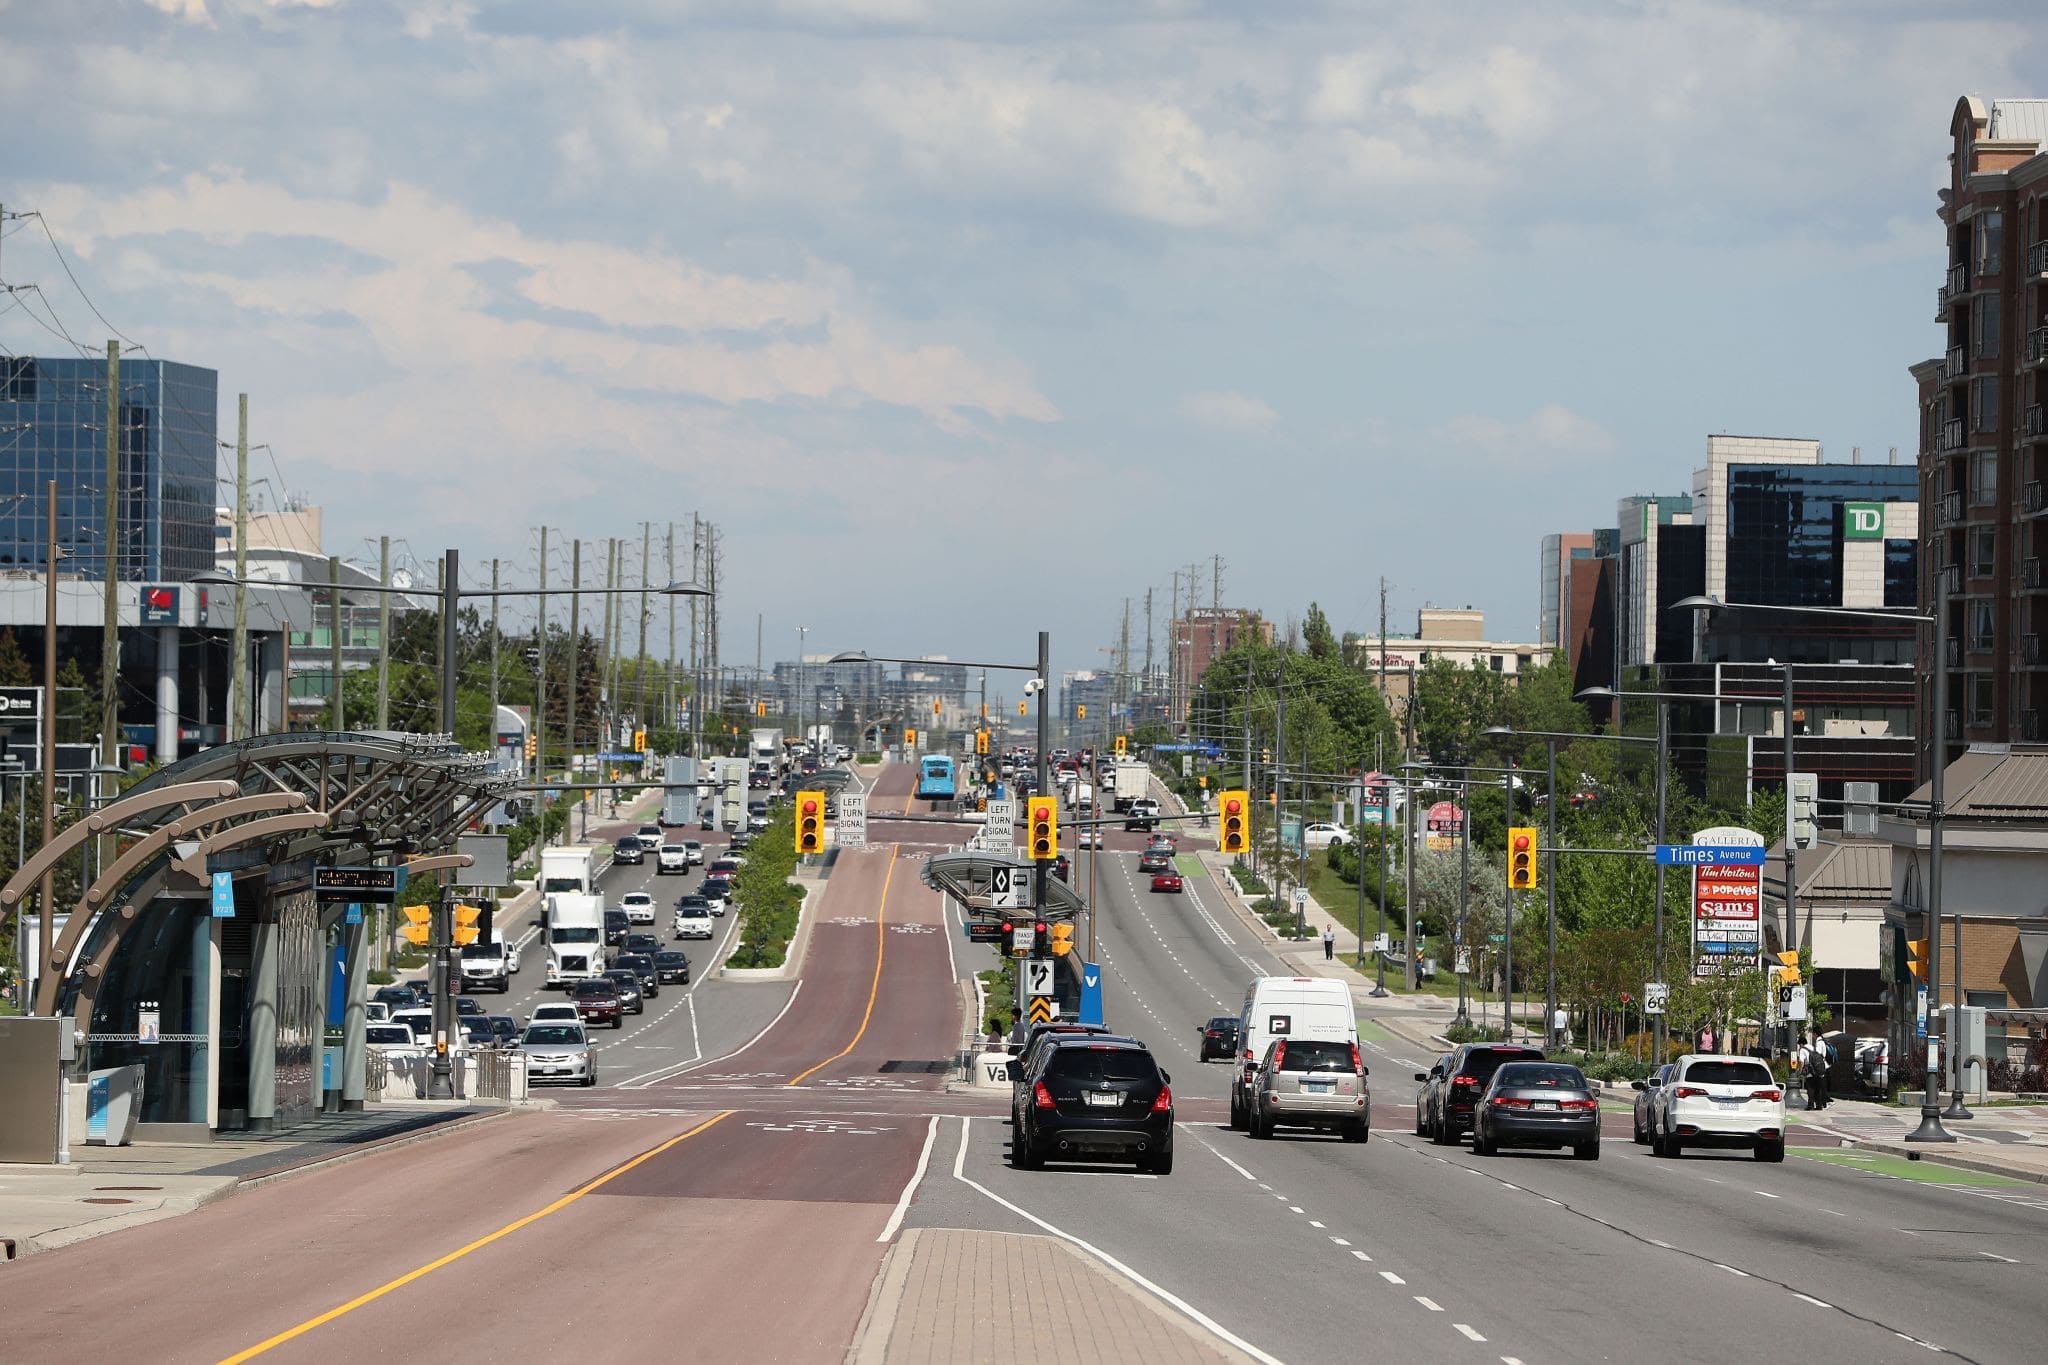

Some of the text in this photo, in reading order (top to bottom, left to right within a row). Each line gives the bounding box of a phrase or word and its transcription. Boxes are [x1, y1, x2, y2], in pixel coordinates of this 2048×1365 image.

[1849, 508, 1881, 531] TD
[843, 798, 861, 807] LEFT
[843, 809, 863, 817] TURN
[991, 805, 1009, 814] LEFT
[840, 820, 863, 828] SIGNAL
[990, 816, 1010, 825] TURN
[989, 827, 1011, 836] SIGNAL
[1697, 836, 1759, 847] GALLERIA
[1670, 847, 1751, 862] Times Avenue
[1700, 865, 1755, 878] Tim Hortons
[1700, 901, 1754, 917] Sam's
[1648, 996, 1667, 1009] 60
